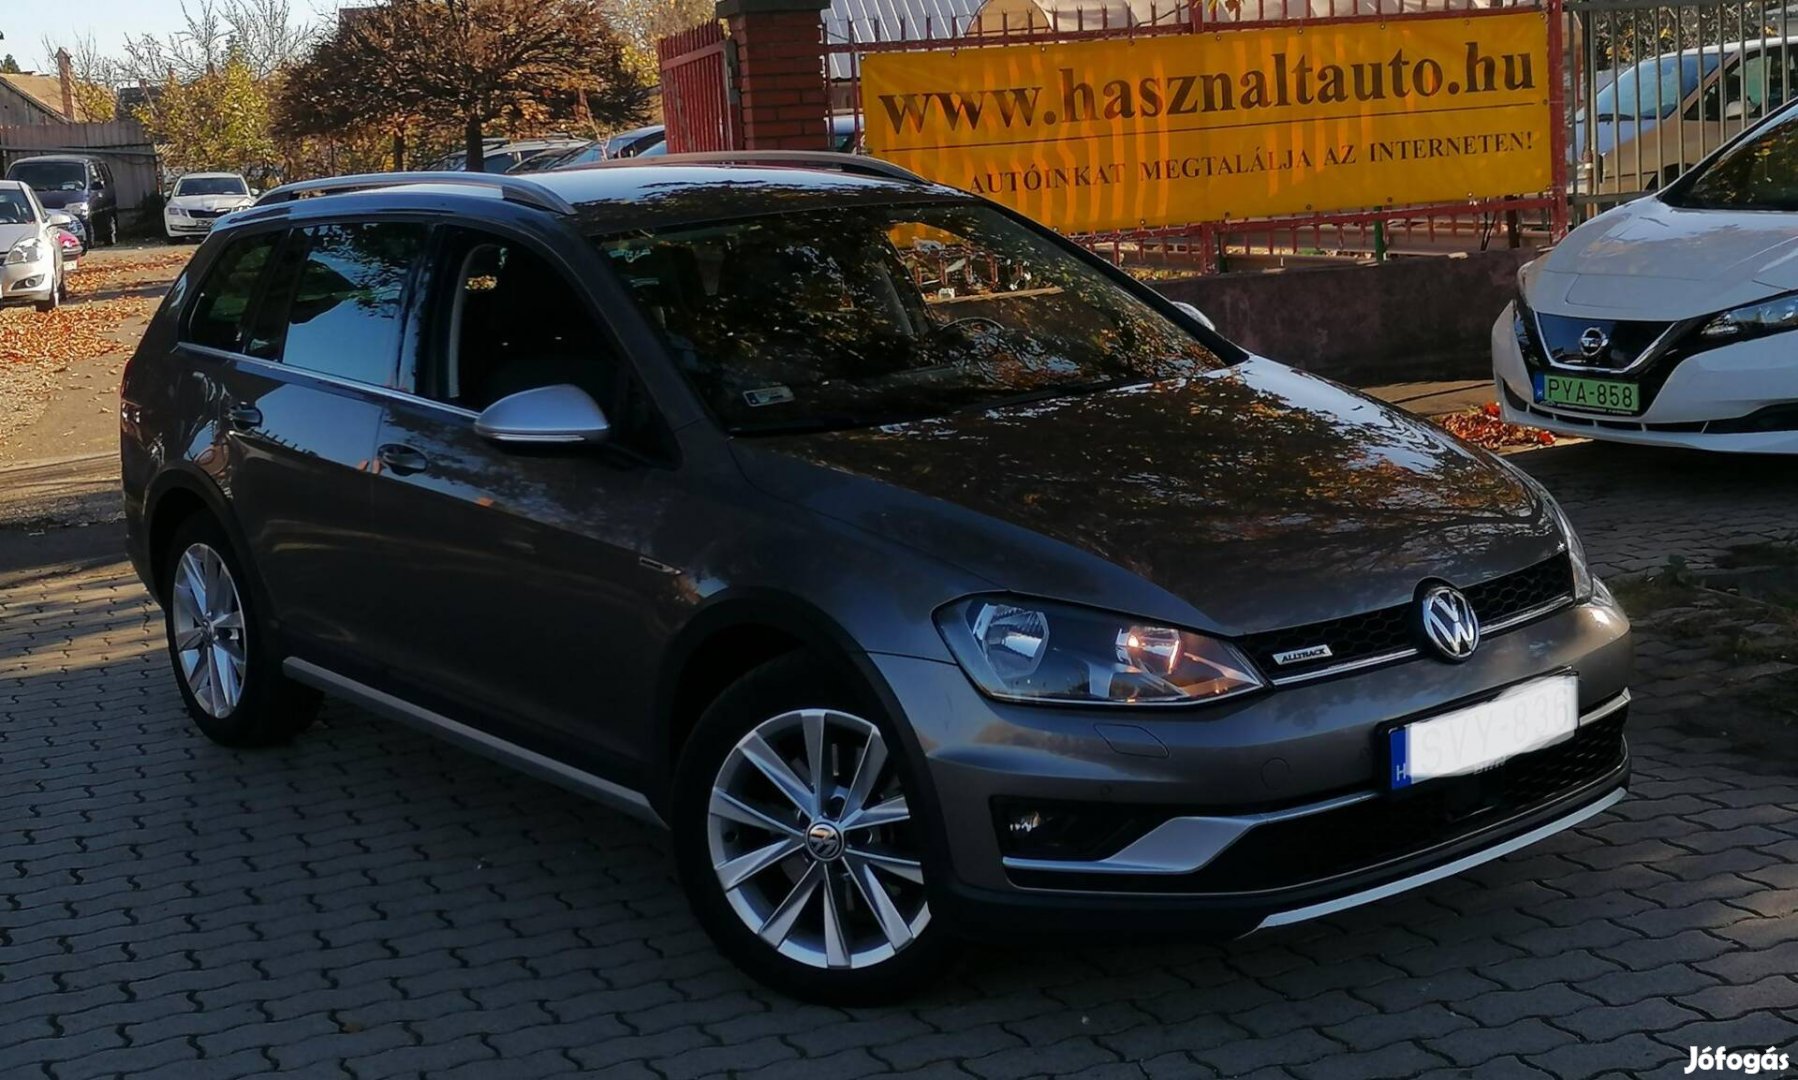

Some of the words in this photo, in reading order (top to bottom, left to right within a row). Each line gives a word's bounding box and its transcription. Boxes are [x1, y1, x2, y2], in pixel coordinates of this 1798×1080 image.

[878, 41, 1536, 136] www.hasznaltauto.hu
[969, 163, 1126, 194] AUTÓINKAT
[1138, 146, 1313, 182] MEGTALÁLJA
[1323, 144, 1357, 167] AZ
[1369, 130, 1533, 163] INTERNETEN!
[1548, 378, 1633, 412] PYA-858
[1280, 647, 1326, 663] ALLTRACK
